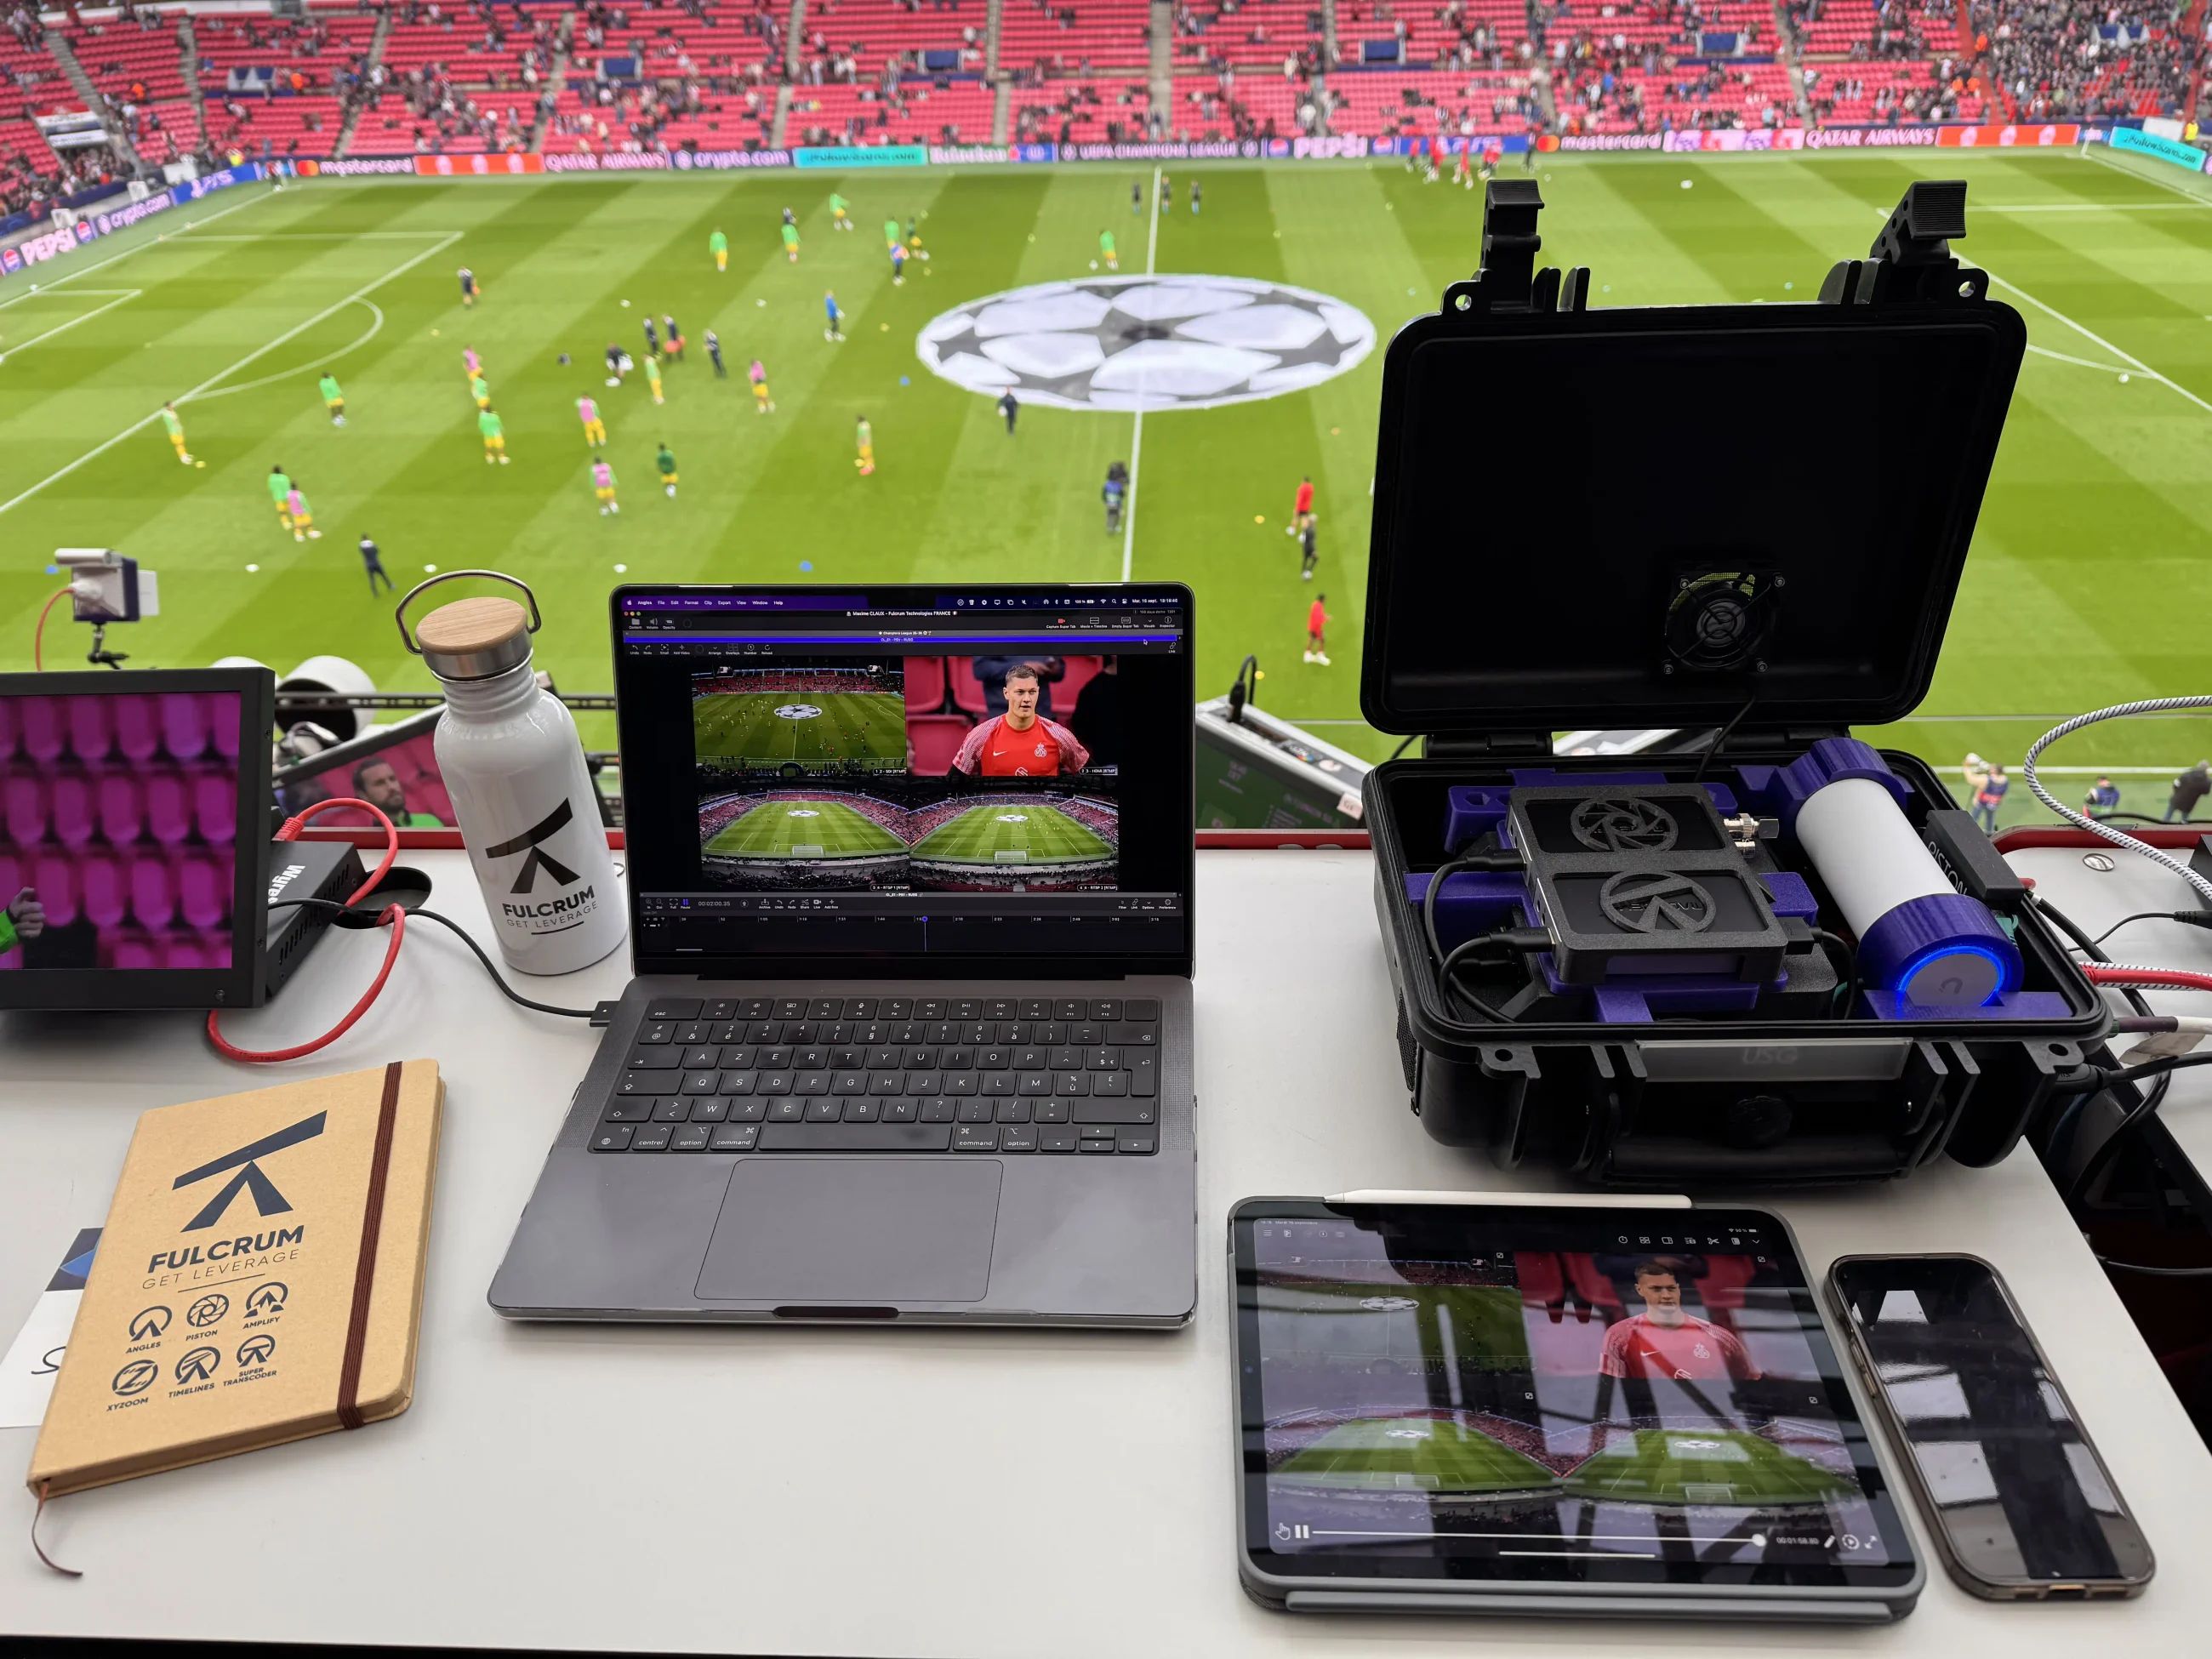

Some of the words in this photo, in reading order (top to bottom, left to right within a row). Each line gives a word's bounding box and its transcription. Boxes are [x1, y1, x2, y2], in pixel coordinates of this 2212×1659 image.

[1294, 134, 1368, 158] PEPSI
[1560, 134, 1661, 151] mastercard
[1806, 130, 1861, 148] QATAR
[1870, 128, 1936, 145] AIRWAYS
[693, 149, 790, 168] crypto.com
[1080, 144, 1114, 159] UEFA
[1115, 143, 1189, 159] CHAMPIONS
[1189, 141, 1239, 158] LEAGUE
[320, 157, 413, 174] mastercard
[545, 153, 599, 174] QATAR
[601, 152, 665, 169] AIRWAYS
[111, 193, 171, 227] crypto.com
[20, 226, 77, 266] PEPSI
[502, 885, 595, 918] FULCRUM
[507, 920, 528, 928] GET
[536, 901, 597, 928] LEVERAGE
[148, 1225, 304, 1273] FULCRUM
[142, 1273, 182, 1289] GET
[193, 1249, 299, 1279] LEVERAGE
[242, 1316, 281, 1329] AMPLIFY
[185, 1330, 218, 1341] PISTON
[125, 1342, 161, 1354] ANGLES
[223, 1371, 277, 1387] TRANSCODER
[238, 1367, 265, 1377] SUPER
[168, 1383, 215, 1398] TIMELINES
[106, 1397, 149, 1411] XYZOOM
